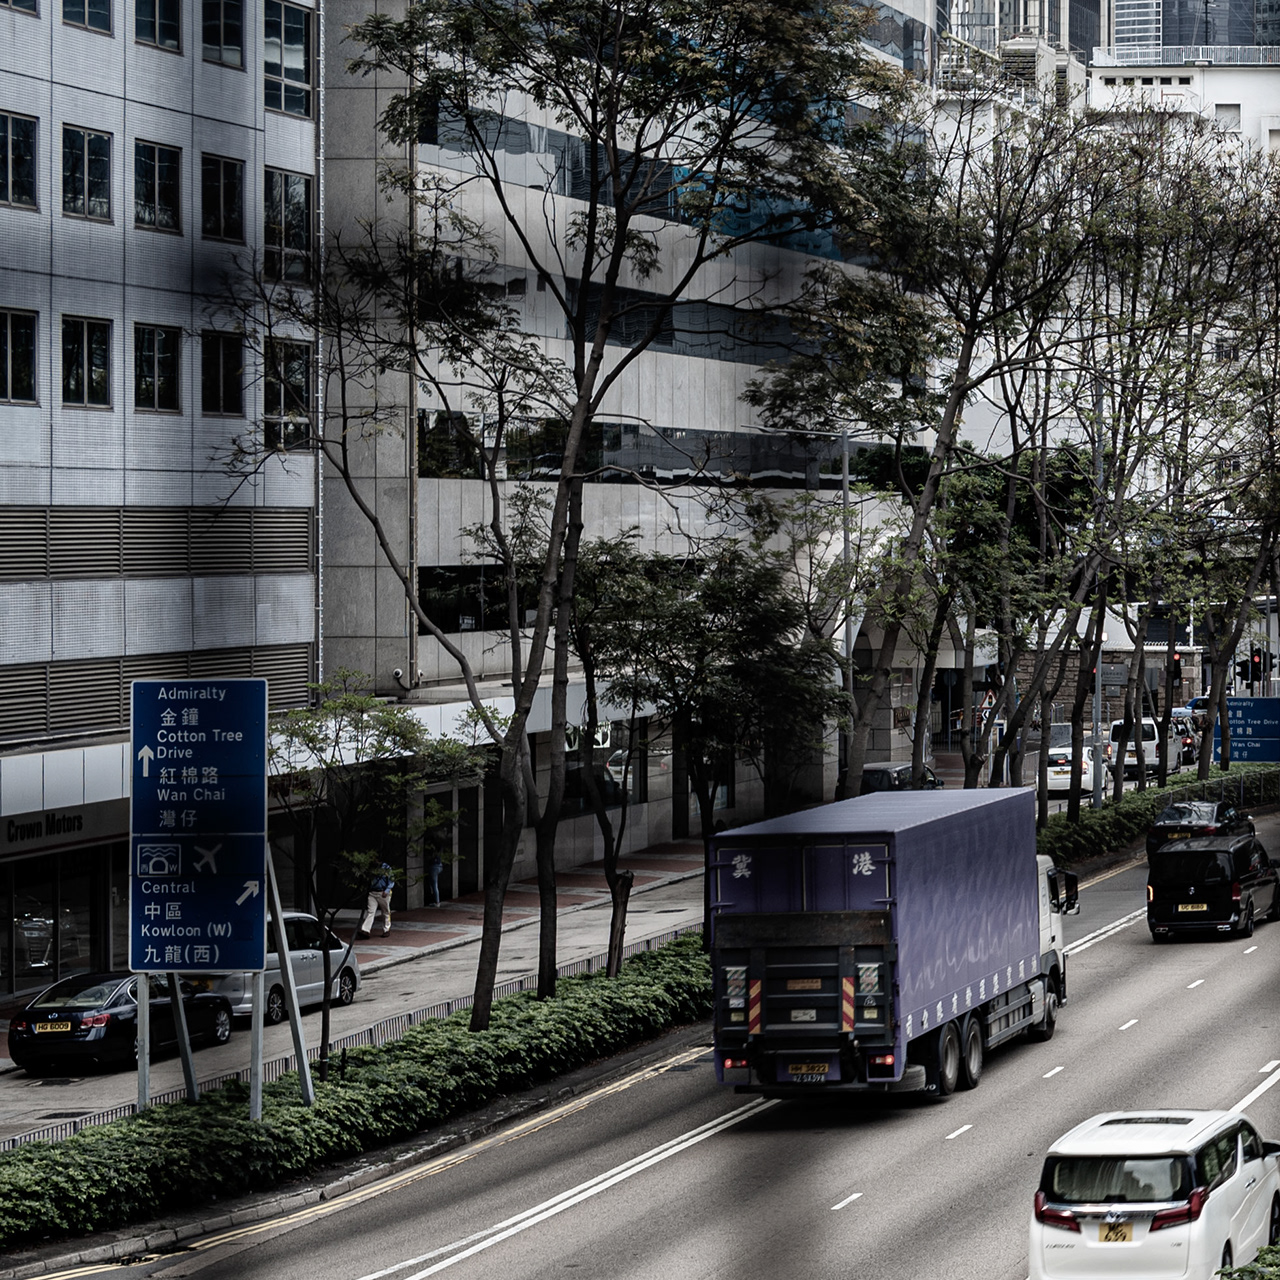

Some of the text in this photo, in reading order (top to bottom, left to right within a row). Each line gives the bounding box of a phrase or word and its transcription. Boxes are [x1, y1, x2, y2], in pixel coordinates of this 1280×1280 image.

[158, 687, 226, 701] Admiralty
[160, 707, 199, 726] 金鐘
[157, 729, 243, 743] Cotton Tree
[157, 746, 193, 759] Drive
[159, 766, 218, 785] 紅棉路
[157, 788, 225, 801] Wan Chai
[159, 809, 197, 828] 灣仔
[7, 813, 83, 843] Crown Motors
[169, 864, 177, 872] W
[852, 851, 877, 876] 港
[141, 881, 196, 894] Central
[144, 901, 182, 920] 中區
[141, 922, 232, 938] Kowloon (W)
[144, 944, 219, 964] 九龍(西)
